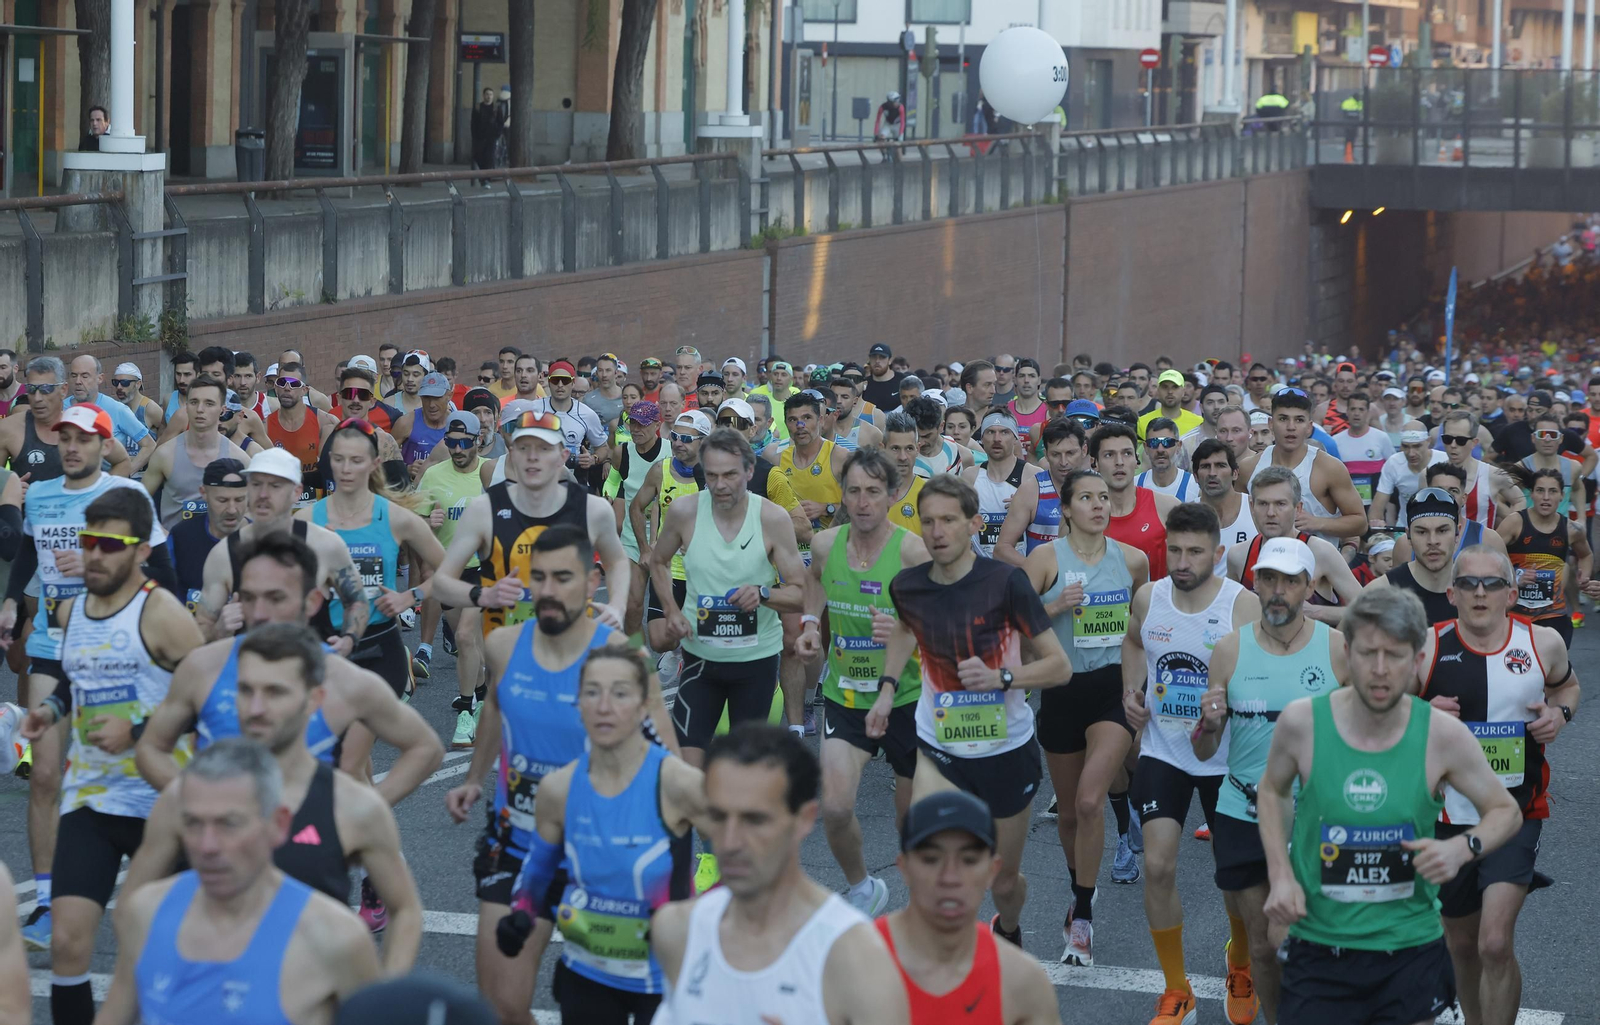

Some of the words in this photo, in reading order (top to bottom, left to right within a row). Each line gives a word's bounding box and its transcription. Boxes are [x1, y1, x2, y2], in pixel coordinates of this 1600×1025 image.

[1094, 594, 1125, 603] ZURICH
[1520, 590, 1543, 599] LUCÍA
[717, 599, 733, 607] ZU
[718, 614, 737, 622] 2982
[1095, 611, 1113, 619] 2524
[712, 624, 743, 636] JØRN
[1083, 621, 1124, 634] MANON
[849, 666, 878, 678] ORBE
[85, 688, 129, 704] ZURICH
[957, 693, 996, 704] ZURICH
[1177, 692, 1196, 702] 7710
[961, 713, 980, 722] 1926
[944, 724, 998, 740] DANIELE
[1474, 725, 1516, 736] ZURICH
[1487, 758, 1510, 772] ON
[1353, 829, 1404, 842] ZURICH
[1354, 853, 1382, 865] 3127
[1346, 867, 1390, 884] ALEX
[590, 896, 640, 916] ZURICH
